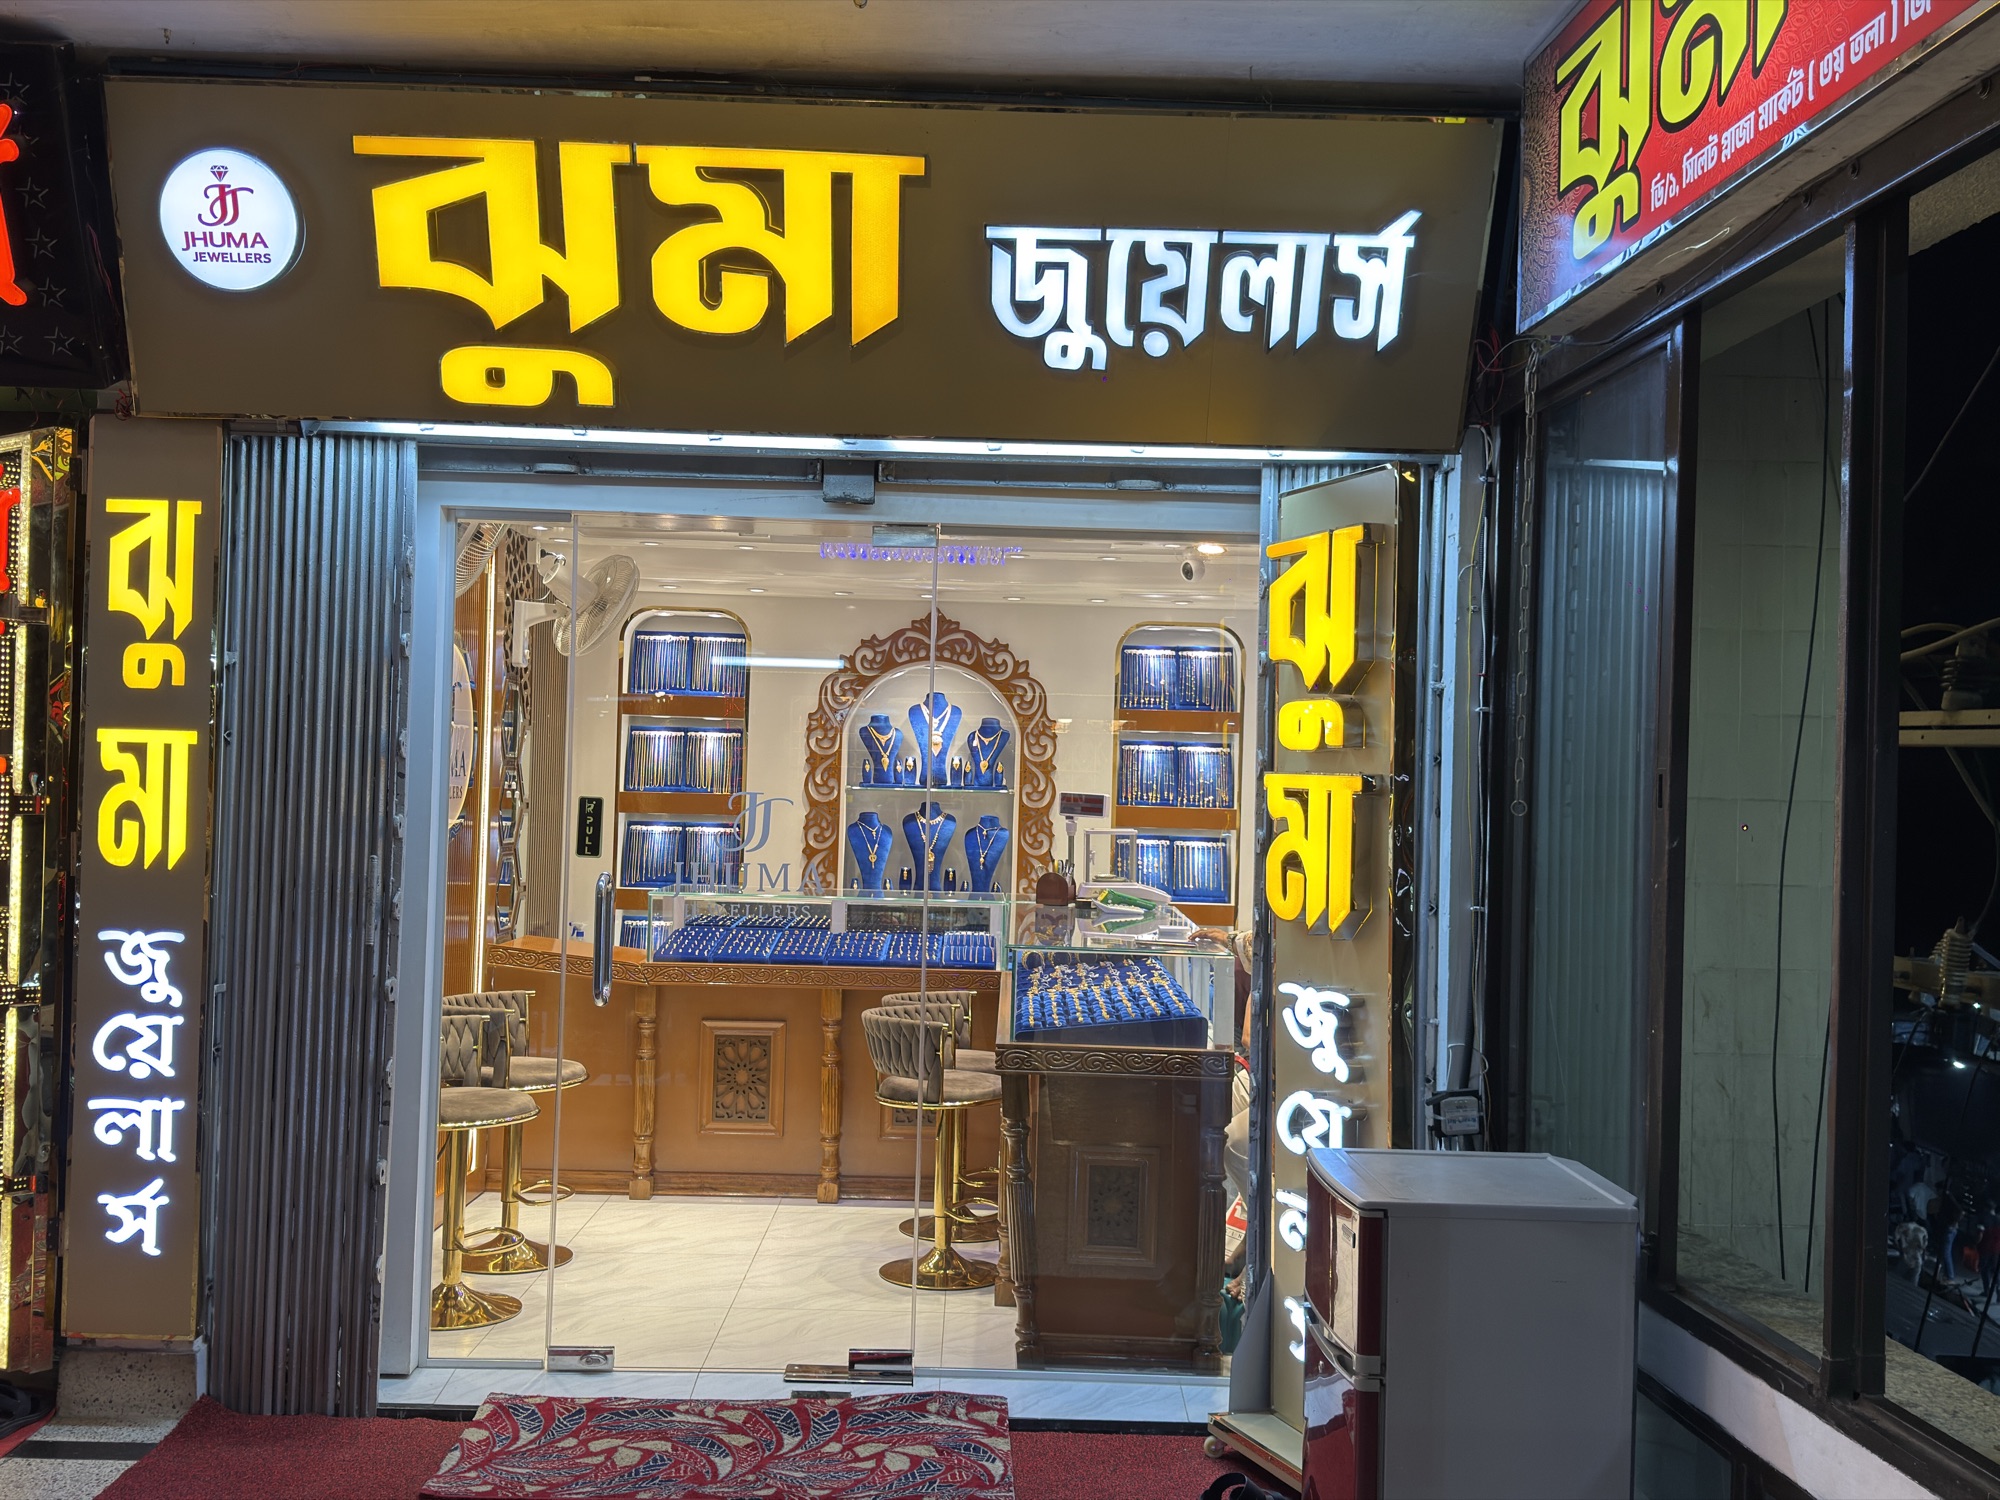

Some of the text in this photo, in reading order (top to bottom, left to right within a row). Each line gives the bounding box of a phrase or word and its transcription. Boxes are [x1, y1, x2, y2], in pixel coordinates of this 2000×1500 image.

[1682, 134, 1719, 189] সিলেট
[1721, 111, 1755, 163] প্লাজা
[1758, 67, 1804, 131] মার্কেট
[1850, 11, 1886, 65] তলা
[182, 231, 269, 252] JHUMA
[193, 252, 272, 264] JEWELLERS
[352, 134, 1423, 407] ঝুমা জুয়েলার্স
[1264, 523, 1365, 934] ঝুমা
[88, 498, 203, 1257] ঝুমা জুয়েলার্স
[584, 816, 594, 855] PULL
[673, 861, 826, 898] JHUMA
